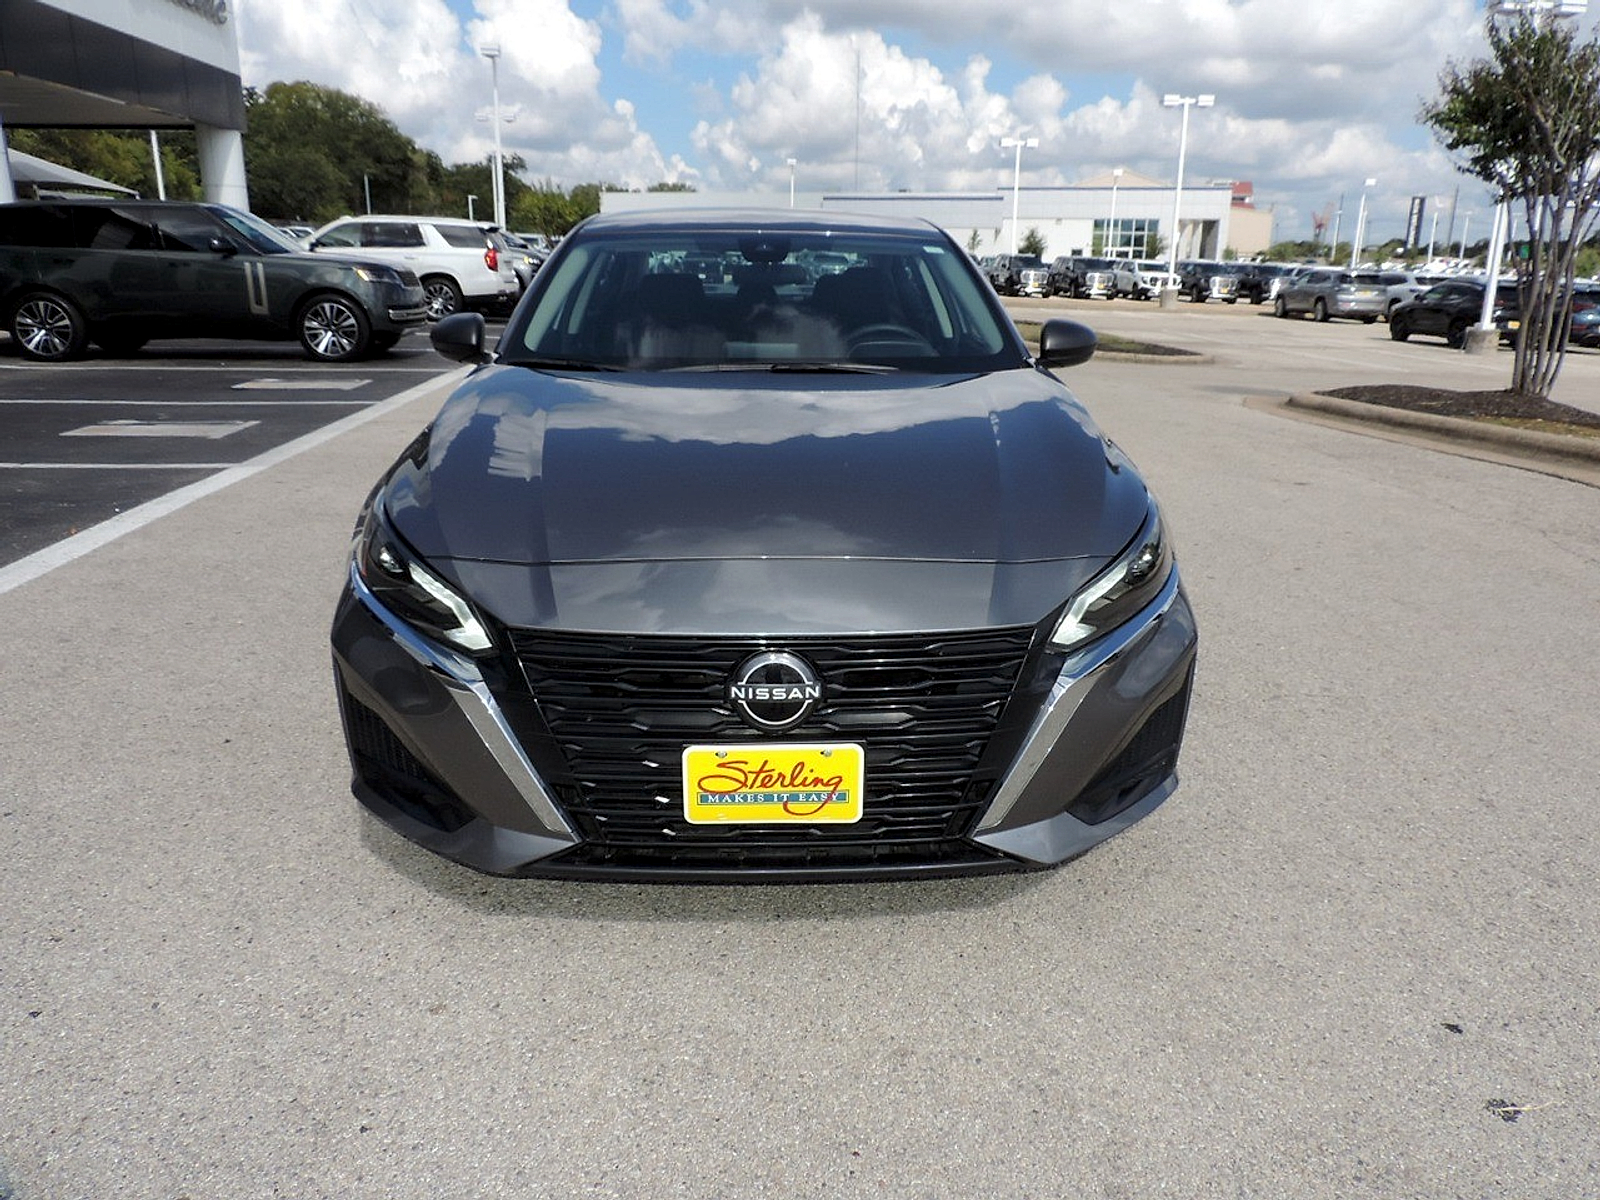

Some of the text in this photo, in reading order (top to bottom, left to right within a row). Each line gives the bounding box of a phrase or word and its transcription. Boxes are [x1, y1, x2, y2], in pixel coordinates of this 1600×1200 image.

[730, 686, 820, 700] NISSAN
[697, 760, 843, 816] Sterling
[708, 791, 839, 803] MAKES IT EASY
